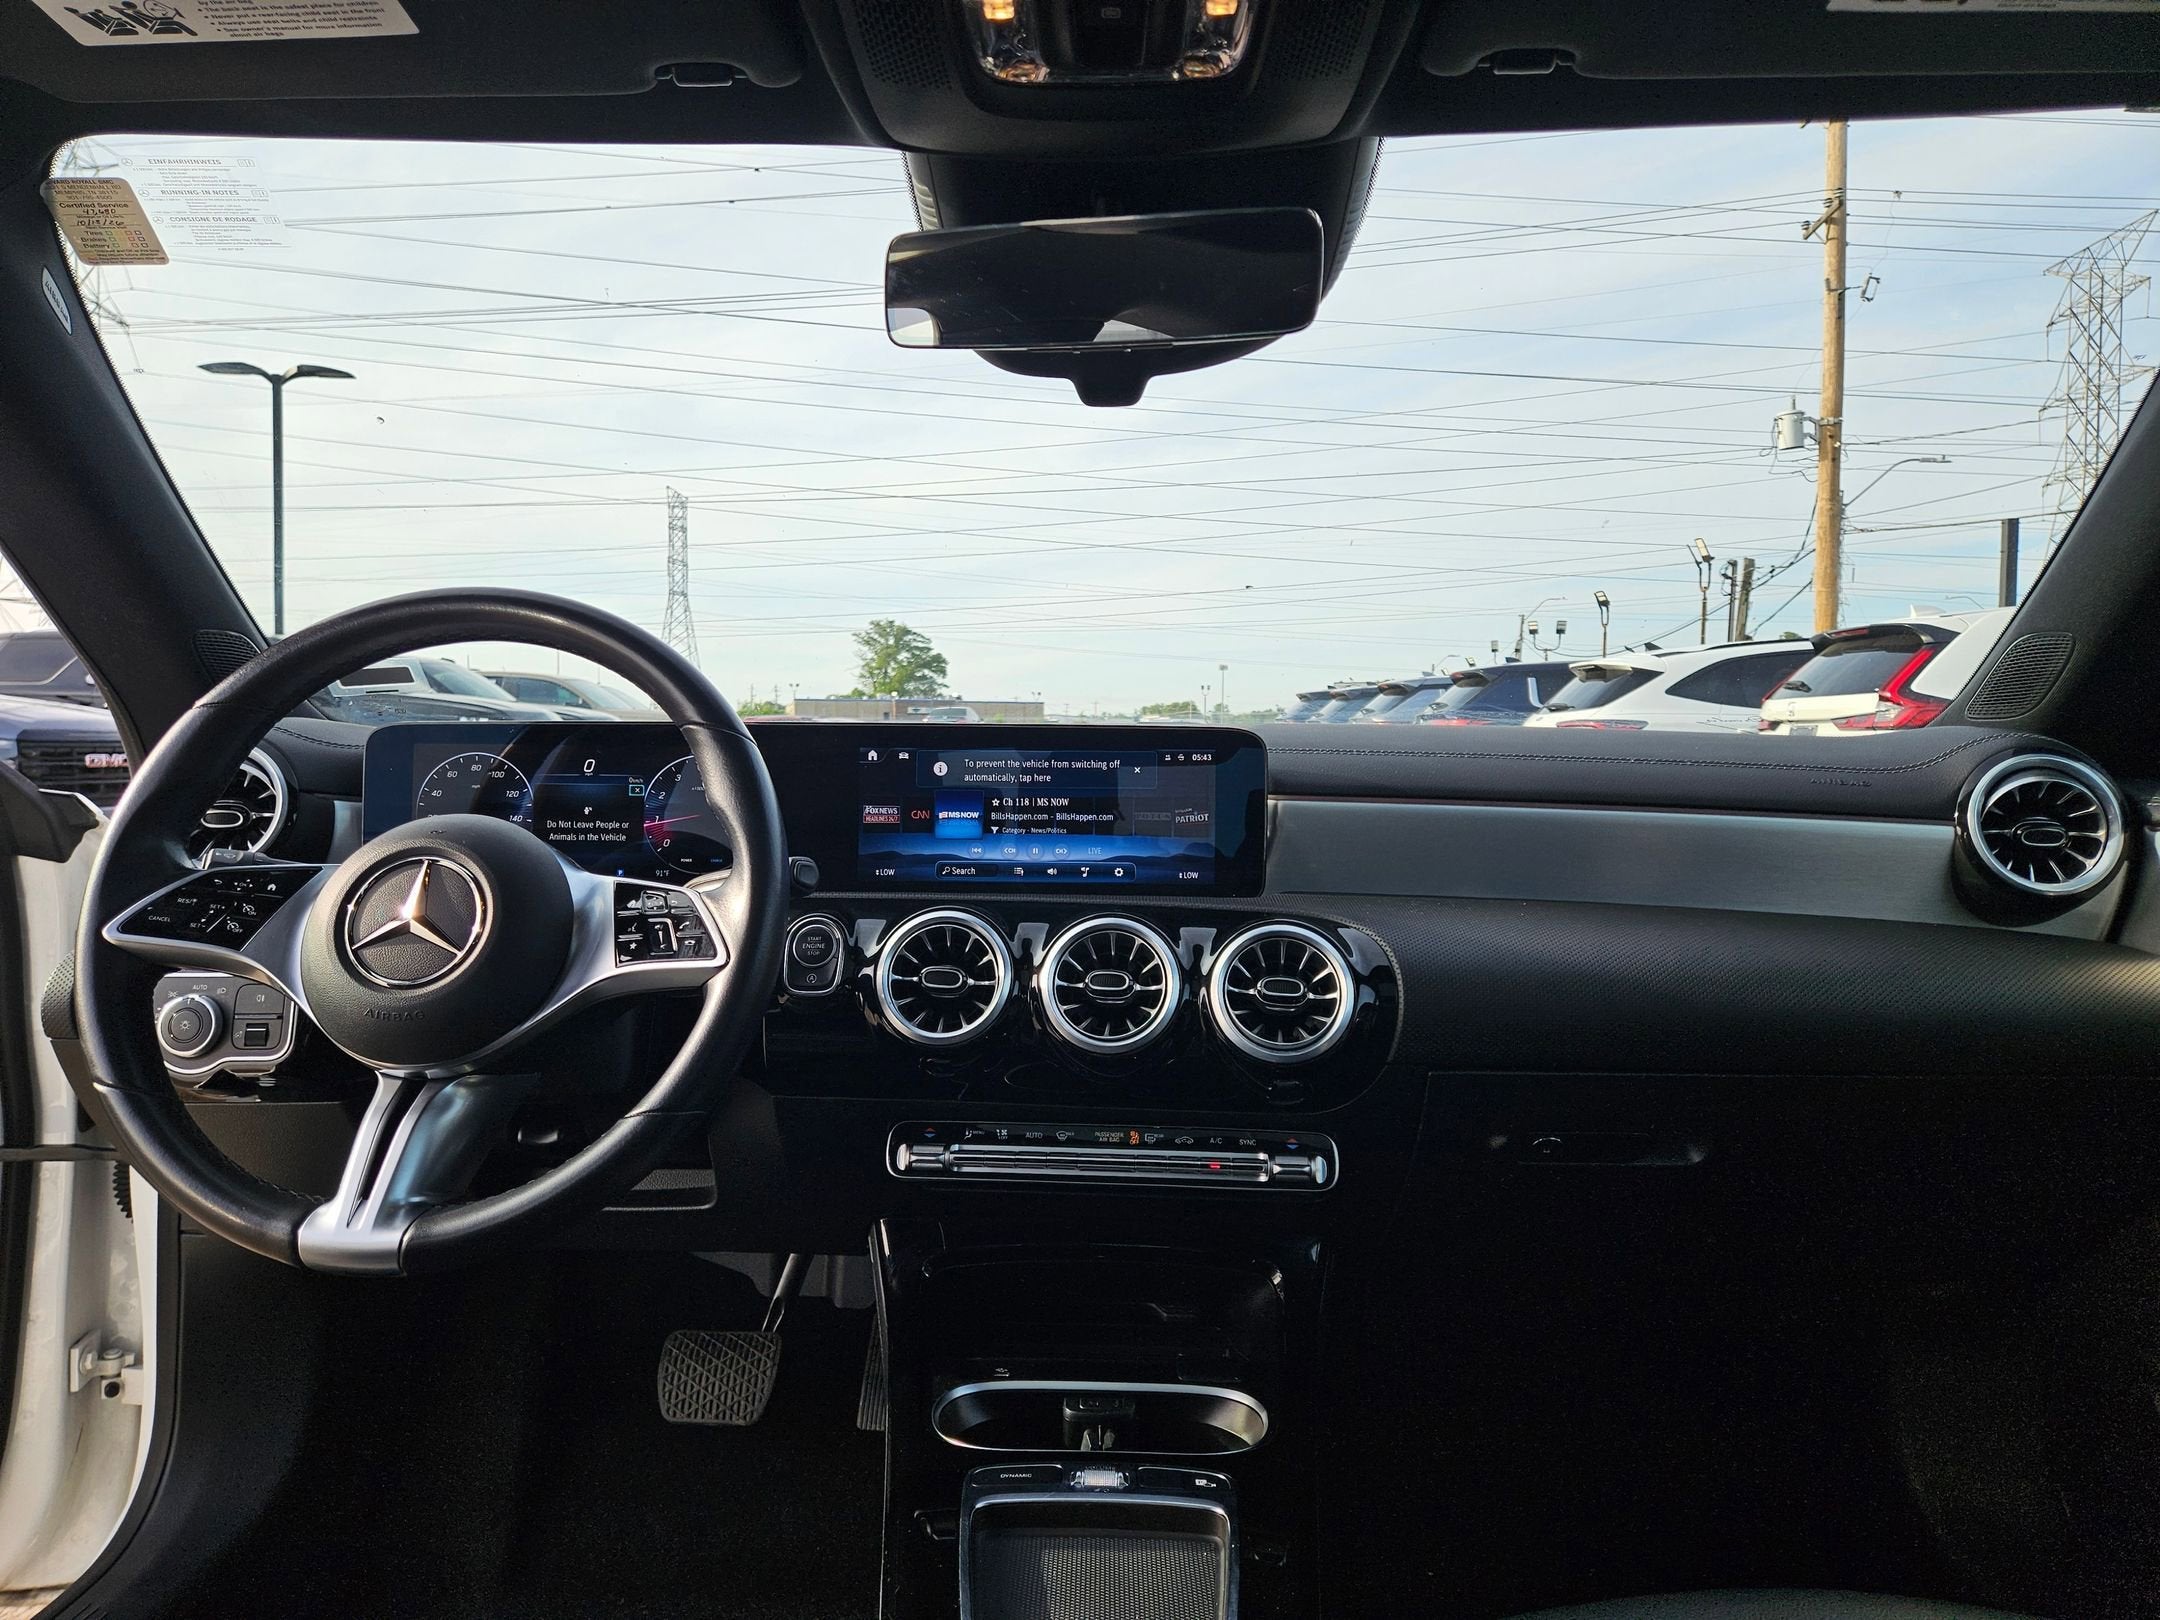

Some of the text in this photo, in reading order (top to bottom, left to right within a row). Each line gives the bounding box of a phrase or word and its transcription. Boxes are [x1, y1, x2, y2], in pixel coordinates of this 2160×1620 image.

[85, 753, 128, 769] GMC
[1191, 753, 1212, 761] 05:43
[471, 764, 482, 772] 80
[583, 758, 596, 773] 0
[964, 758, 1121, 771] To prevent the vehicle from switching off
[446, 770, 505, 779] 60 100
[674, 774, 682, 782] 3
[964, 773, 1052, 784] automatically, tap here
[505, 790, 520, 798] 120
[658, 791, 666, 800] 2
[1002, 797, 1070, 807] Ch 118 MS NOW
[509, 815, 523, 823] 140
[911, 810, 930, 819] CNN
[990, 812, 1114, 822] BillsHappen.com BillsHappen.com
[546, 820, 557, 829] Do
[558, 820, 572, 829] Not
[573, 820, 594, 829] Leave
[595, 820, 620, 831] People
[1002, 827, 1067, 835] Category News/Politics
[549, 832, 627, 842] Animals in the Vehicle
[663, 838, 671, 848] 0
[1087, 847, 1102, 855] LIVE
[880, 868, 895, 876] LOW
[951, 867, 976, 876] Search
[1183, 871, 1199, 879] LOW
[148, 915, 171, 923] CANCEL
[363, 1008, 425, 1021] AIRBAG
[1094, 1131, 1125, 1139] PASSENGER
[1209, 1137, 1223, 1145] A/C
[1239, 1138, 1257, 1146] SYNC
